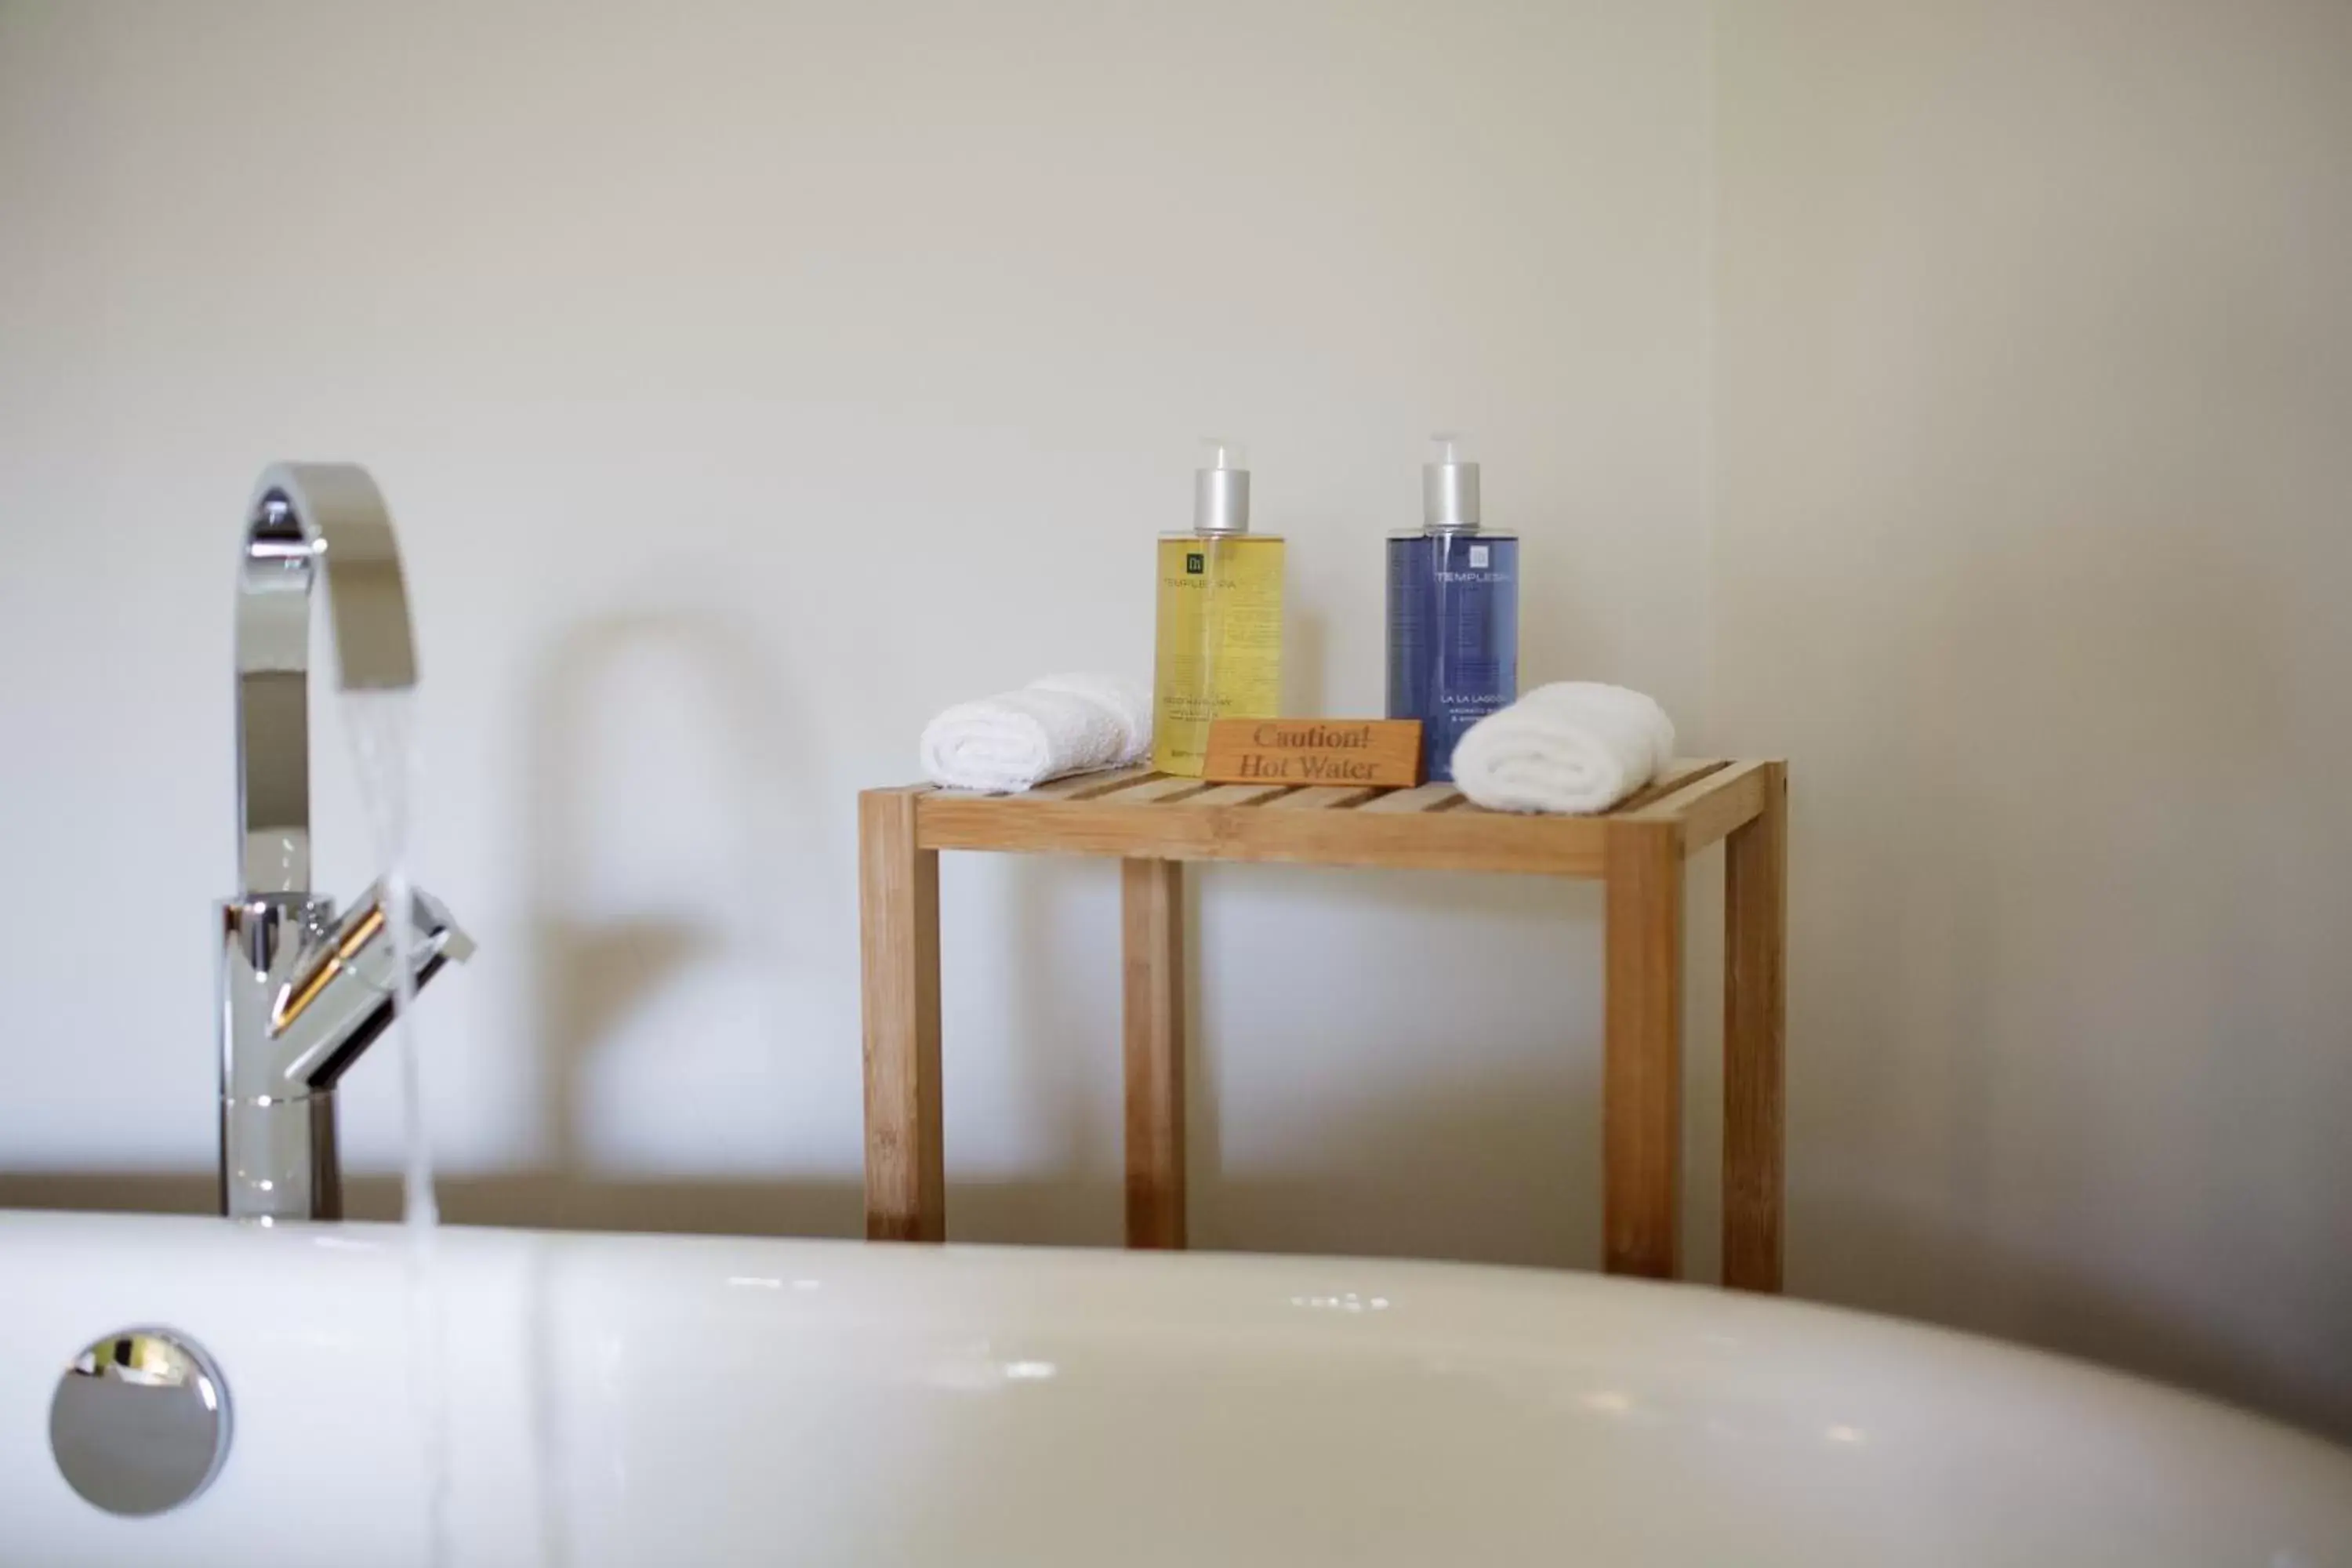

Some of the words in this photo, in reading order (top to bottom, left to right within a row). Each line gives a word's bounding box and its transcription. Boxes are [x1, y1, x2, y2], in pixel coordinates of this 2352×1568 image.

[1163, 579, 1236, 590] TEMPLEPA
[1440, 695, 1454, 703] LA
[1456, 695, 1469, 703] LA
[1254, 724, 1371, 749] Caution!
[1240, 753, 1290, 778] Hot
[1298, 754, 1381, 779] Water
